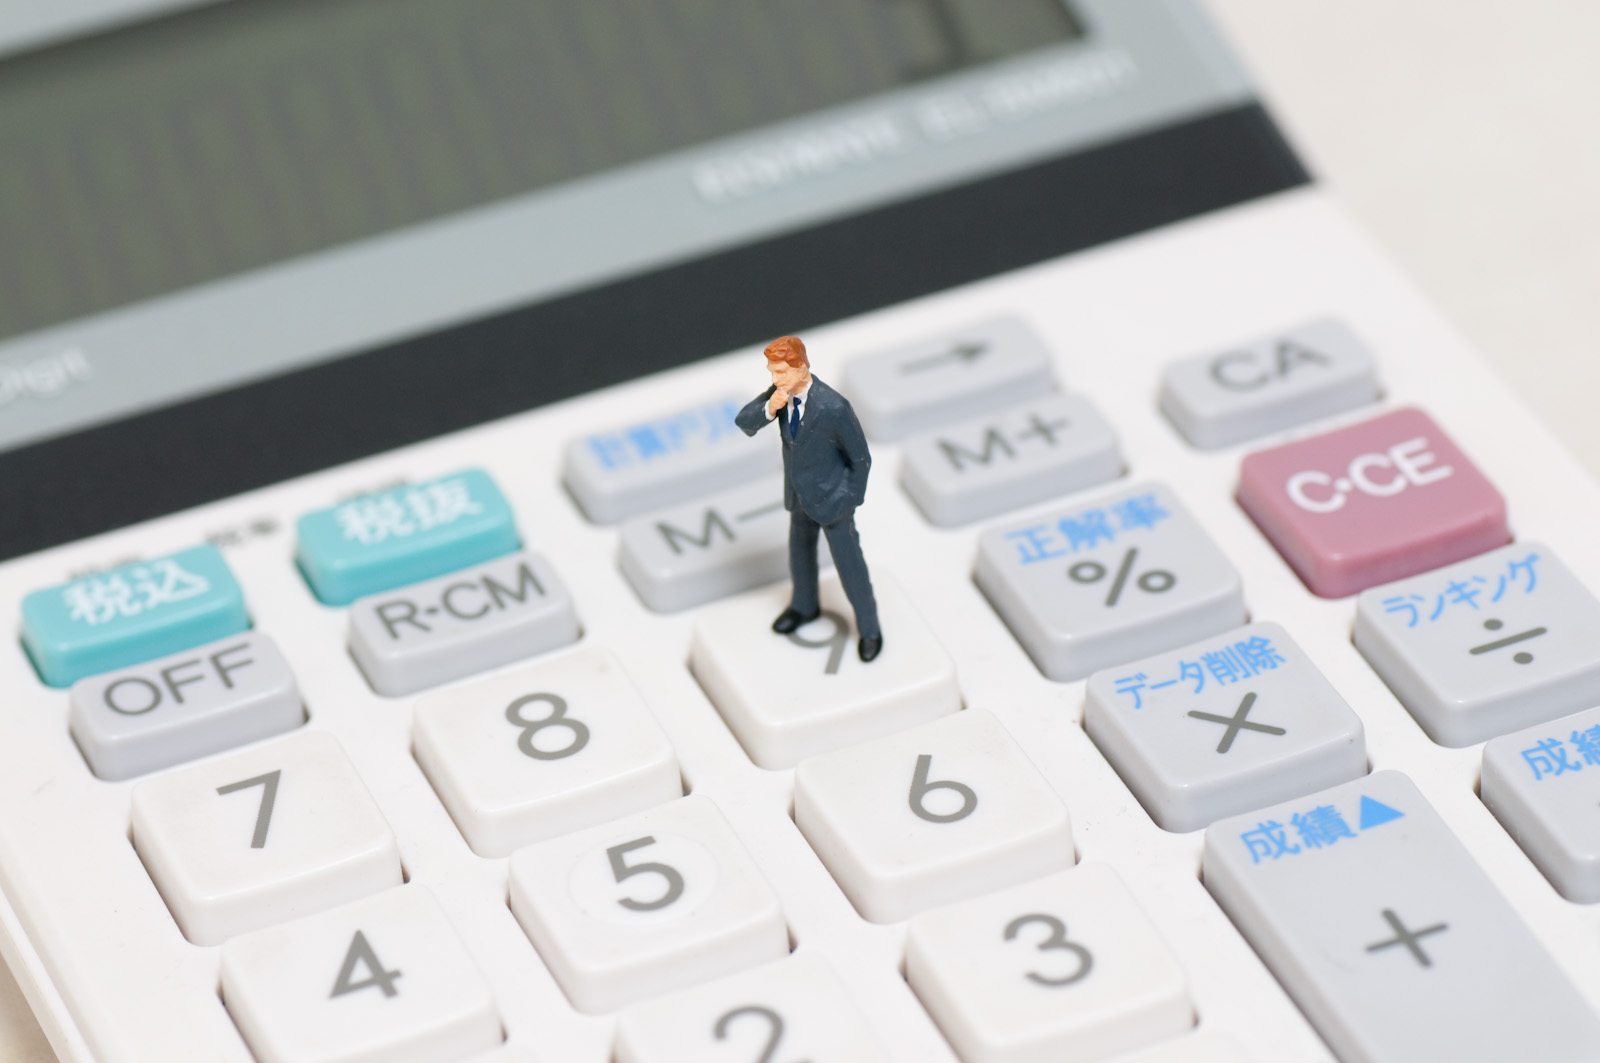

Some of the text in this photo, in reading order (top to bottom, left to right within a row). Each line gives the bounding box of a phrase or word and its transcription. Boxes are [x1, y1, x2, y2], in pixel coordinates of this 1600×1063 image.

[1209, 337, 1333, 392] CA
[936, 413, 1071, 472] M+
[335, 478, 483, 545] 税抜
[1004, 493, 1172, 566] 正解率
[62, 560, 211, 626] 税込
[1067, 547, 1177, 607] %
[1382, 551, 1542, 629] ランキング
[784, 609, 851, 675] 9
[1113, 635, 1287, 710] データ削除
[102, 642, 254, 717] OFF
[505, 692, 590, 761] 8
[216, 769, 281, 849] 7
[908, 754, 978, 824] 6
[606, 836, 685, 912] 5
[329, 929, 403, 999] 4
[1003, 913, 1094, 988] 3
[713, 1005, 814, 1063] 2
